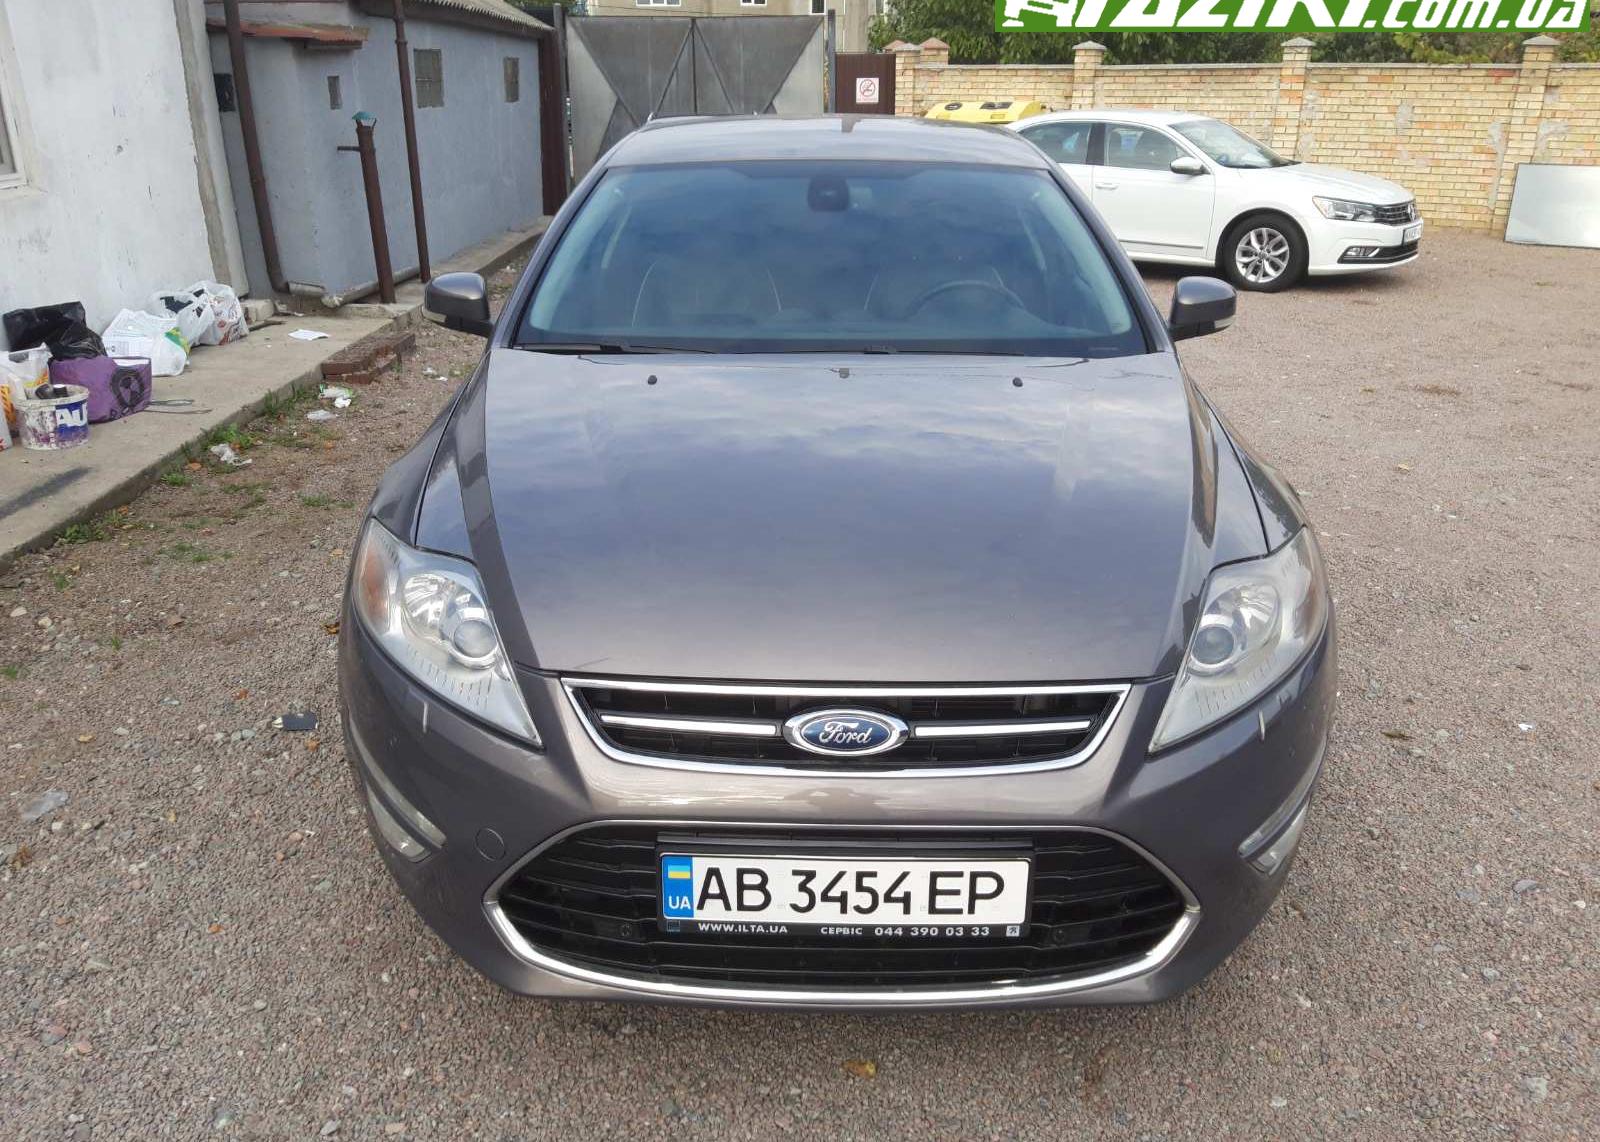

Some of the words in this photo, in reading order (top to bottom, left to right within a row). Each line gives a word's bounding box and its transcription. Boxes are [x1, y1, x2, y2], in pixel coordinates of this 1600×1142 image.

[819, 721, 872, 744] Ford
[696, 867, 772, 912] AB
[789, 870, 911, 915] 3454
[928, 871, 1005, 915] EP
[668, 895, 692, 910] UA
[697, 922, 788, 935] WWW.ILTA.UA
[874, 926, 904, 937] 044
[910, 926, 939, 937] 390
[945, 926, 964, 937] 03
[970, 926, 990, 937] 33
